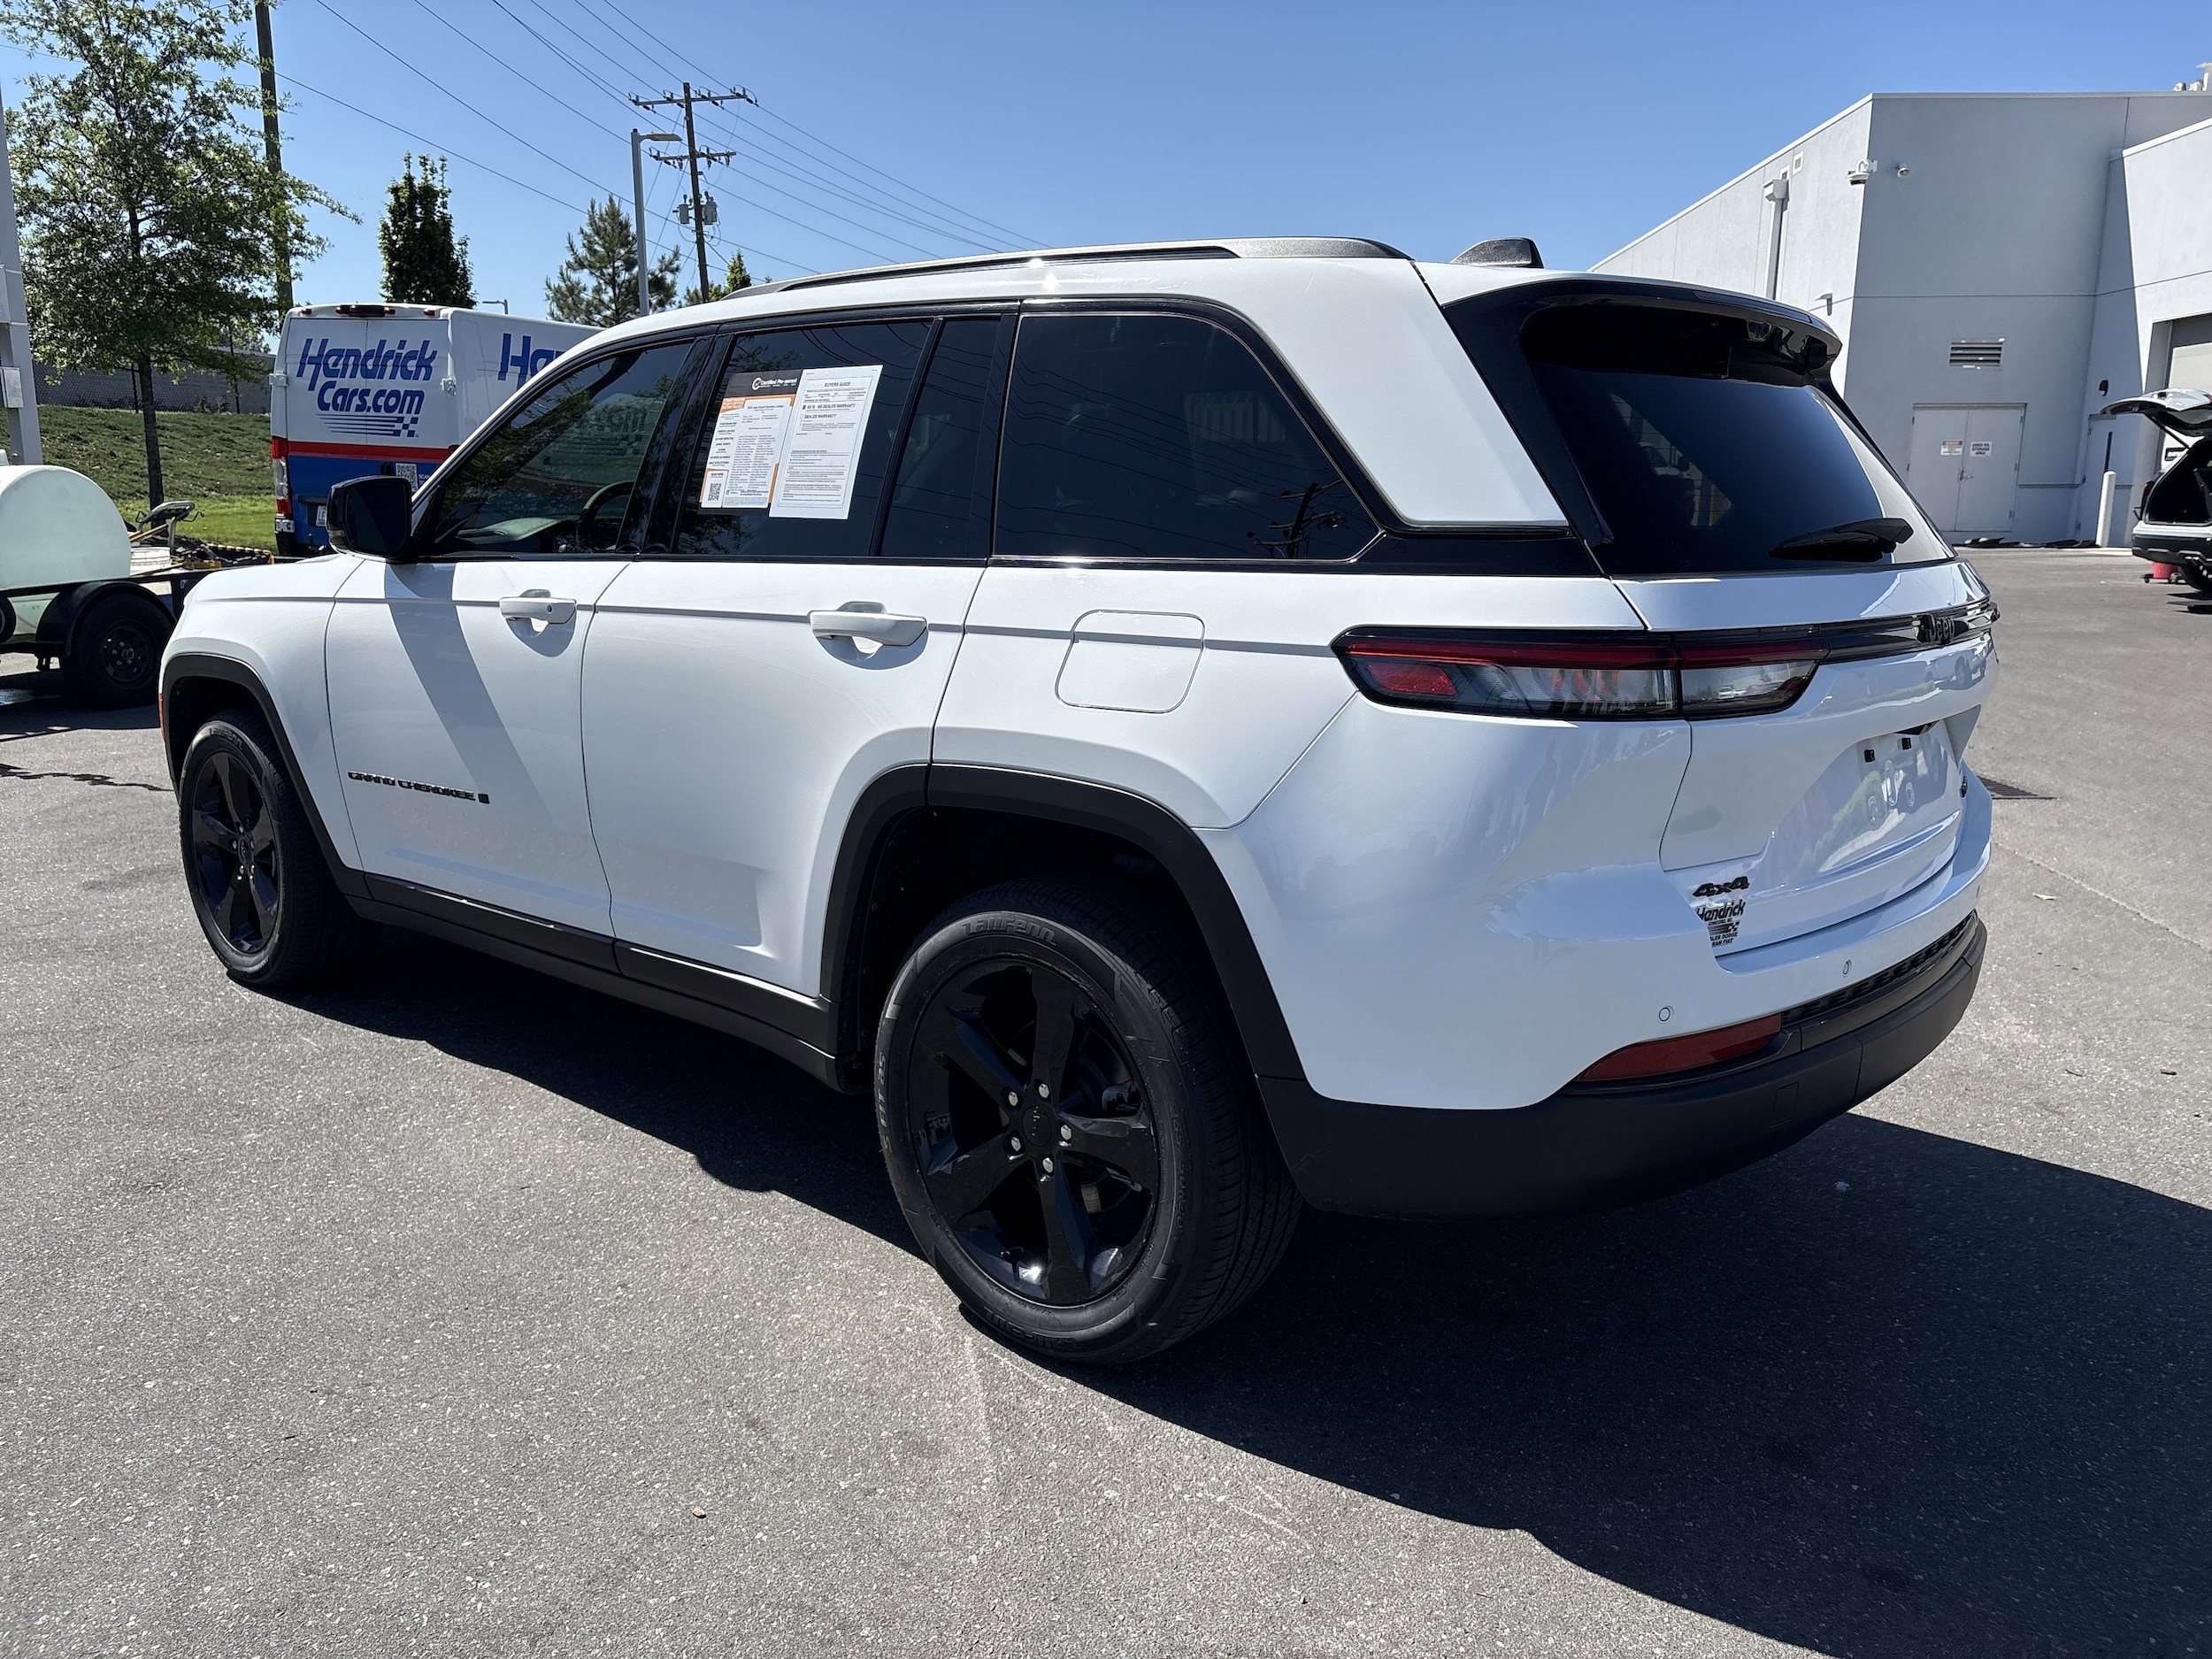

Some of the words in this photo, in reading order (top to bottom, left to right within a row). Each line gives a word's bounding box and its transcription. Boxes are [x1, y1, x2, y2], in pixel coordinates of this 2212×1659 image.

[296, 338, 438, 391] Hendrick
[317, 380, 425, 415] Cars.com
[348, 770, 396, 786] GRAND
[397, 779, 476, 801] CHEROKEE
[1695, 899, 1746, 922] Hendrick
